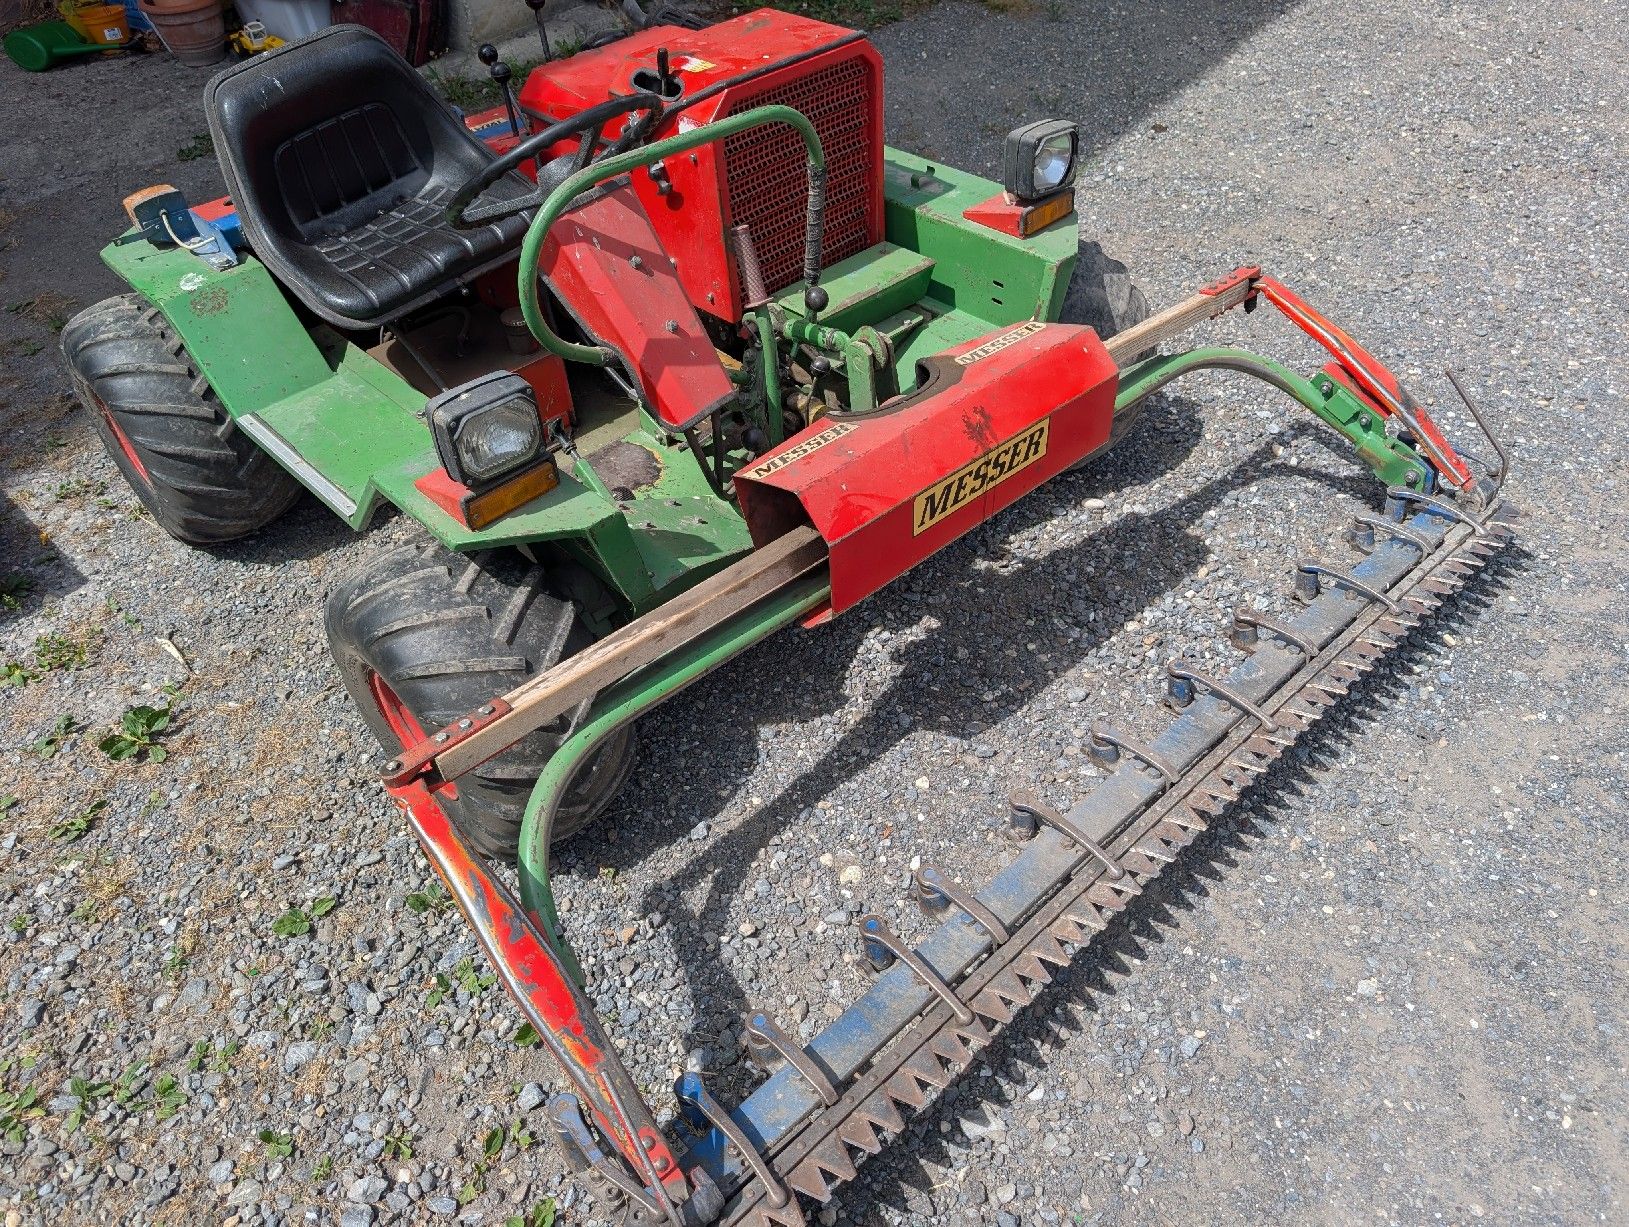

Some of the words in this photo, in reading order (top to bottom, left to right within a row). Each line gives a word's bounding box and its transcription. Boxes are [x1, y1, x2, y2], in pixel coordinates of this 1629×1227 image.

[959, 323, 1041, 363] MESSER
[754, 424, 850, 477] MESSER
[917, 426, 1045, 529] MESSER
